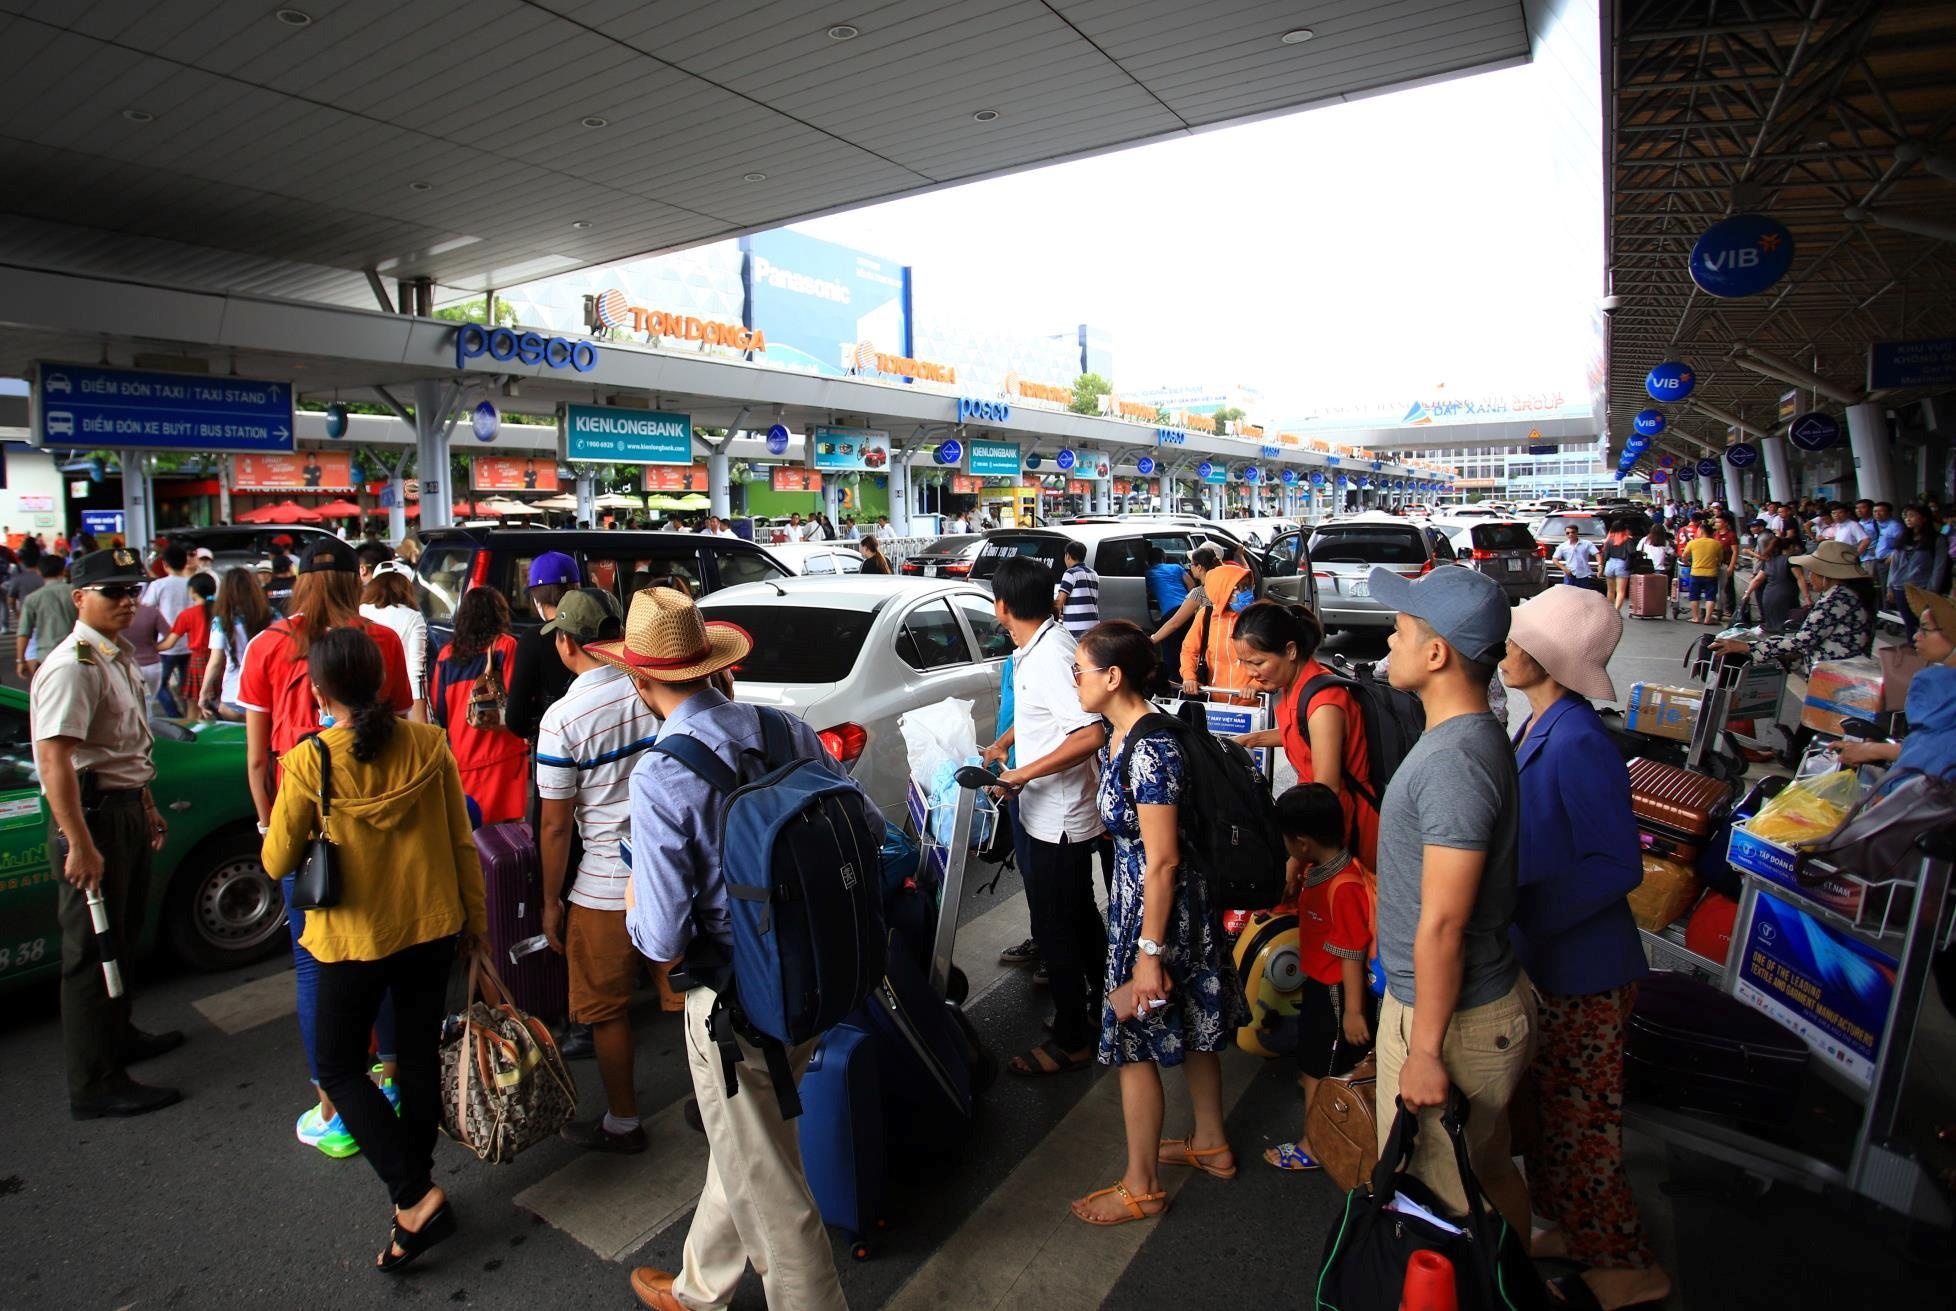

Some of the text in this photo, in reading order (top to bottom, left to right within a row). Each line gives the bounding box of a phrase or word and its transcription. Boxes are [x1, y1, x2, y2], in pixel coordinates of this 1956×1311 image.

[1702, 248, 1760, 272] VIB
[754, 256, 851, 304] Panasonic
[121, 382, 150, 397] ĐÓN
[155, 385, 184, 400] TAXI
[194, 386, 222, 401] TAXI
[225, 389, 266, 404] STAND
[1653, 378, 1679, 389] VIB
[1512, 398, 1565, 412] GROUP
[82, 414, 113, 433] ĐIỂM
[116, 418, 141, 433] ĐÓN
[144, 421, 159, 434] XE
[162, 418, 192, 436] BUÝT
[200, 424, 222, 437] BUS
[224, 425, 267, 439] STATION
[576, 416, 685, 437] KIENLONGBANK
[627, 442, 685, 453] www.kienlongbank.com
[973, 446, 1017, 458] KIENLONGBANK
[1832, 884, 1851, 898] NAM
[16, 938, 46, 966] 38
[1752, 950, 1823, 1000] ONE OF THE LEADING
[1751, 963, 1874, 1049] TEXTILE AND GARMENT MANUFACTURERS
